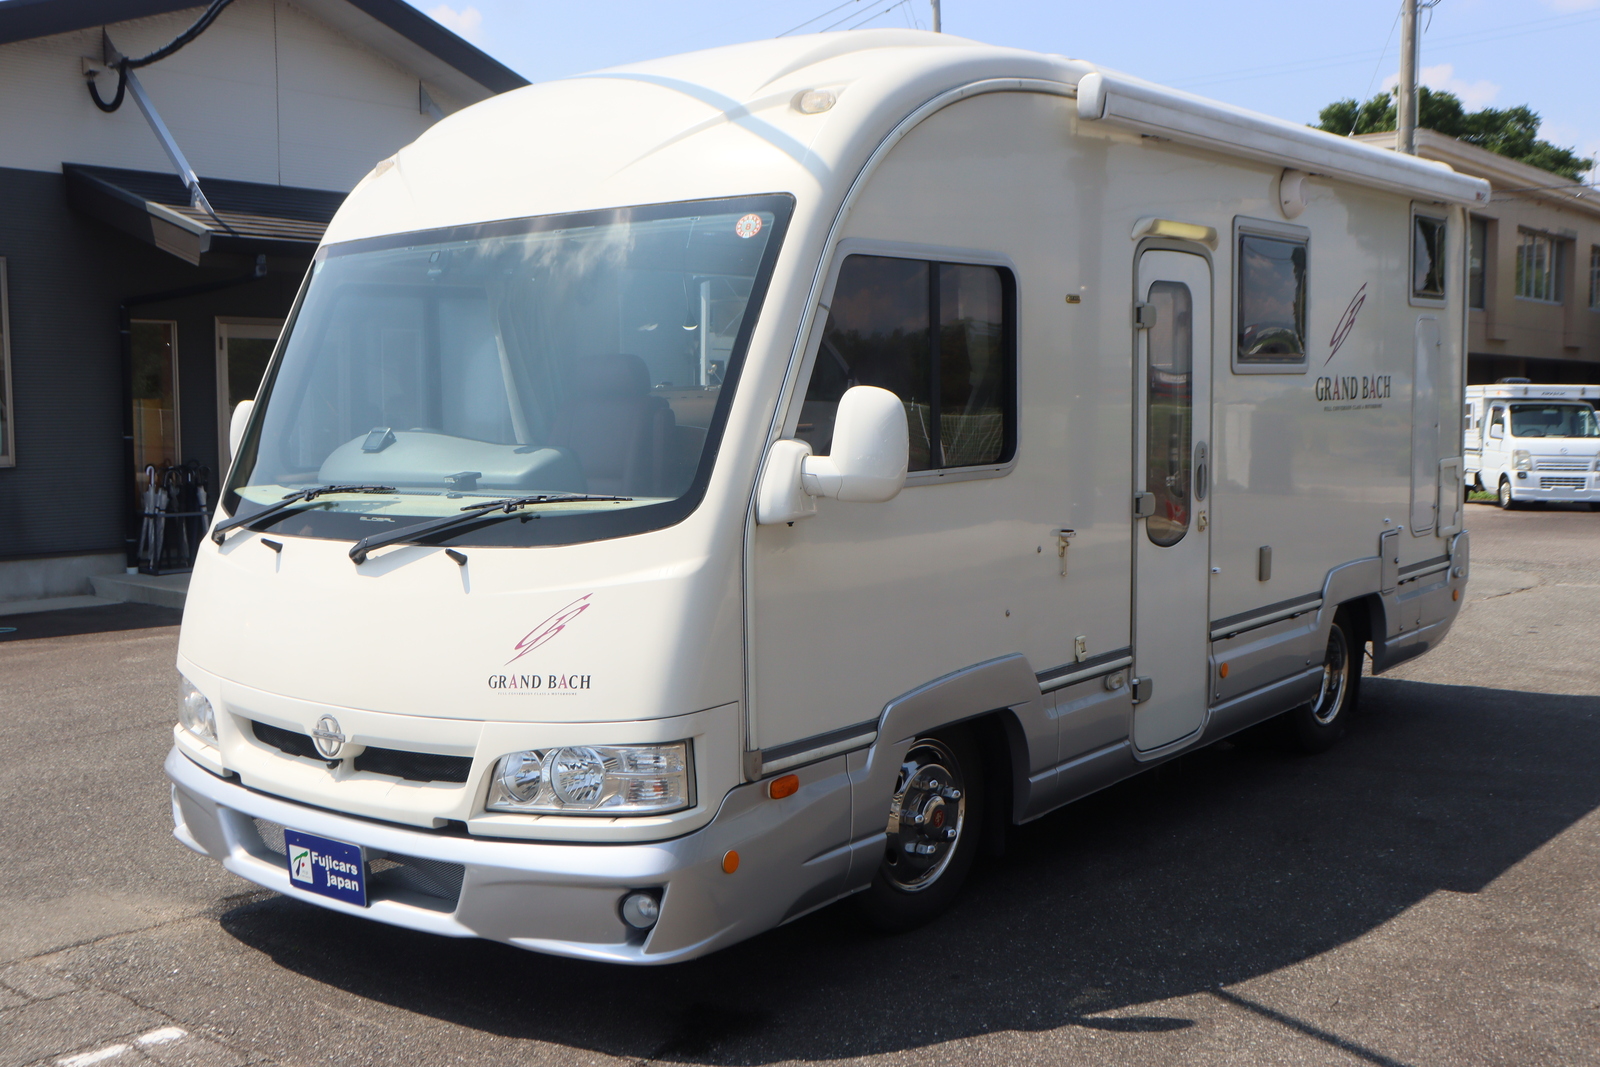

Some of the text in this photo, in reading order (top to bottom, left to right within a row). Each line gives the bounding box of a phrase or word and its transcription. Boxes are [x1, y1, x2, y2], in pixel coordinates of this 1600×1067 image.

[1315, 373, 1391, 402] GRAND BACH
[488, 674, 591, 689] GRAND BACH
[311, 851, 358, 876] Fujicars
[326, 871, 359, 892] japan
